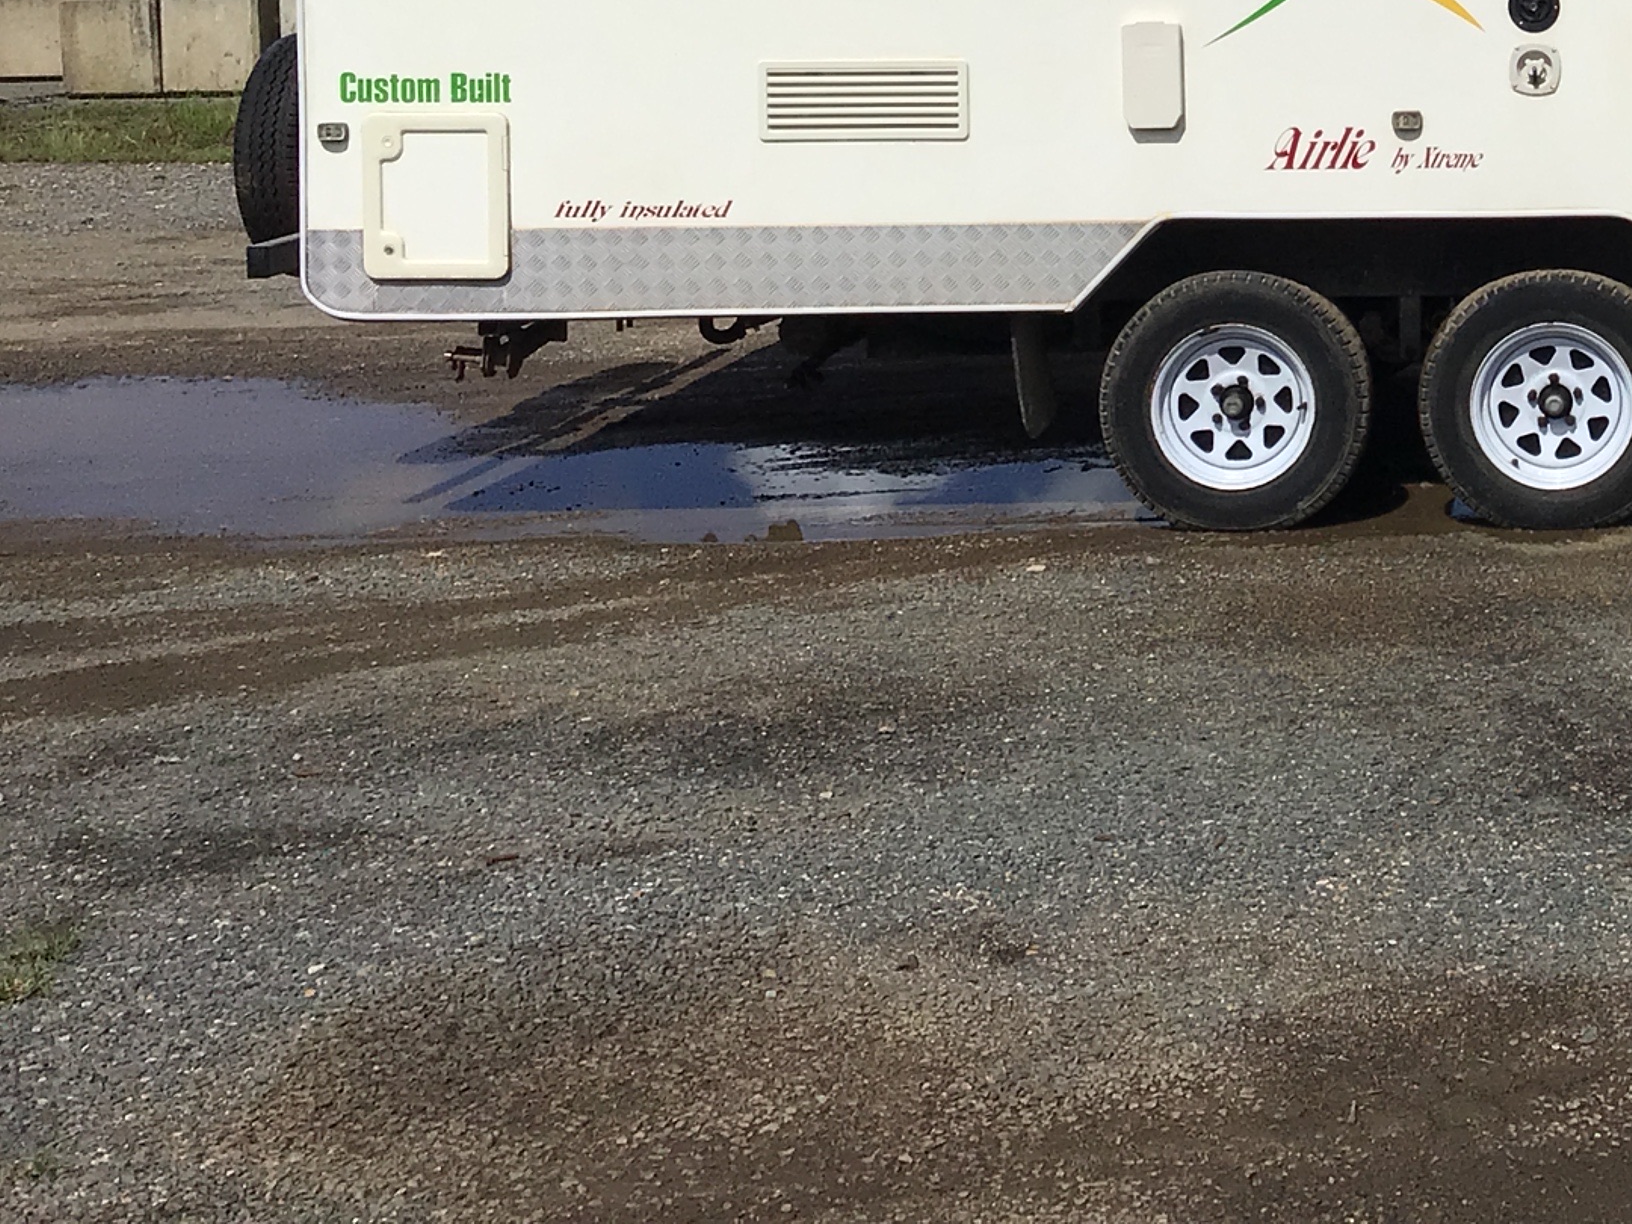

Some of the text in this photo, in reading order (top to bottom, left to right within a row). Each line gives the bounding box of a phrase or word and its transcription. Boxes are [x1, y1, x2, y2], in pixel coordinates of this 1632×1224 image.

[339, 71, 512, 104] Custom Built
[1264, 126, 1485, 175] Airlie by Xtreme
[553, 199, 734, 223] fully insulated
